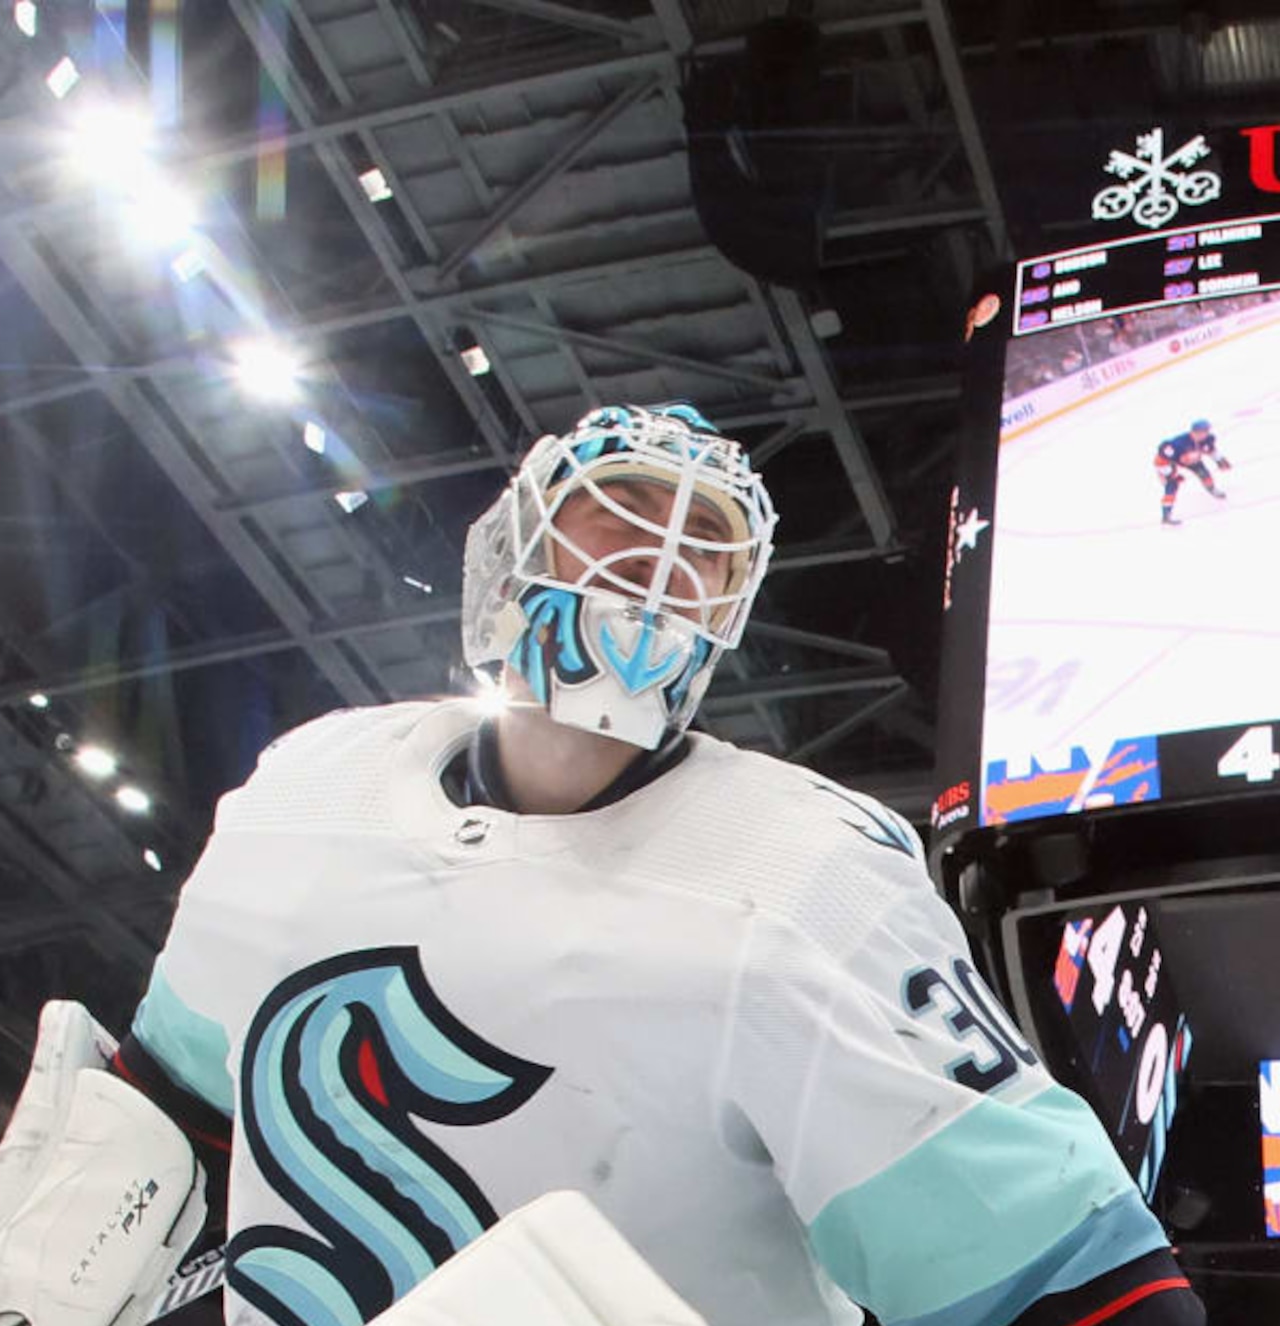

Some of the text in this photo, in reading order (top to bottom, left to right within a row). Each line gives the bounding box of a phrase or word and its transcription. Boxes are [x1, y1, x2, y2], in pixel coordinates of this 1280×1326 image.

[1197, 254, 1224, 271] LEE
[1217, 725, 1280, 783] 4
[938, 781, 970, 813] UBS
